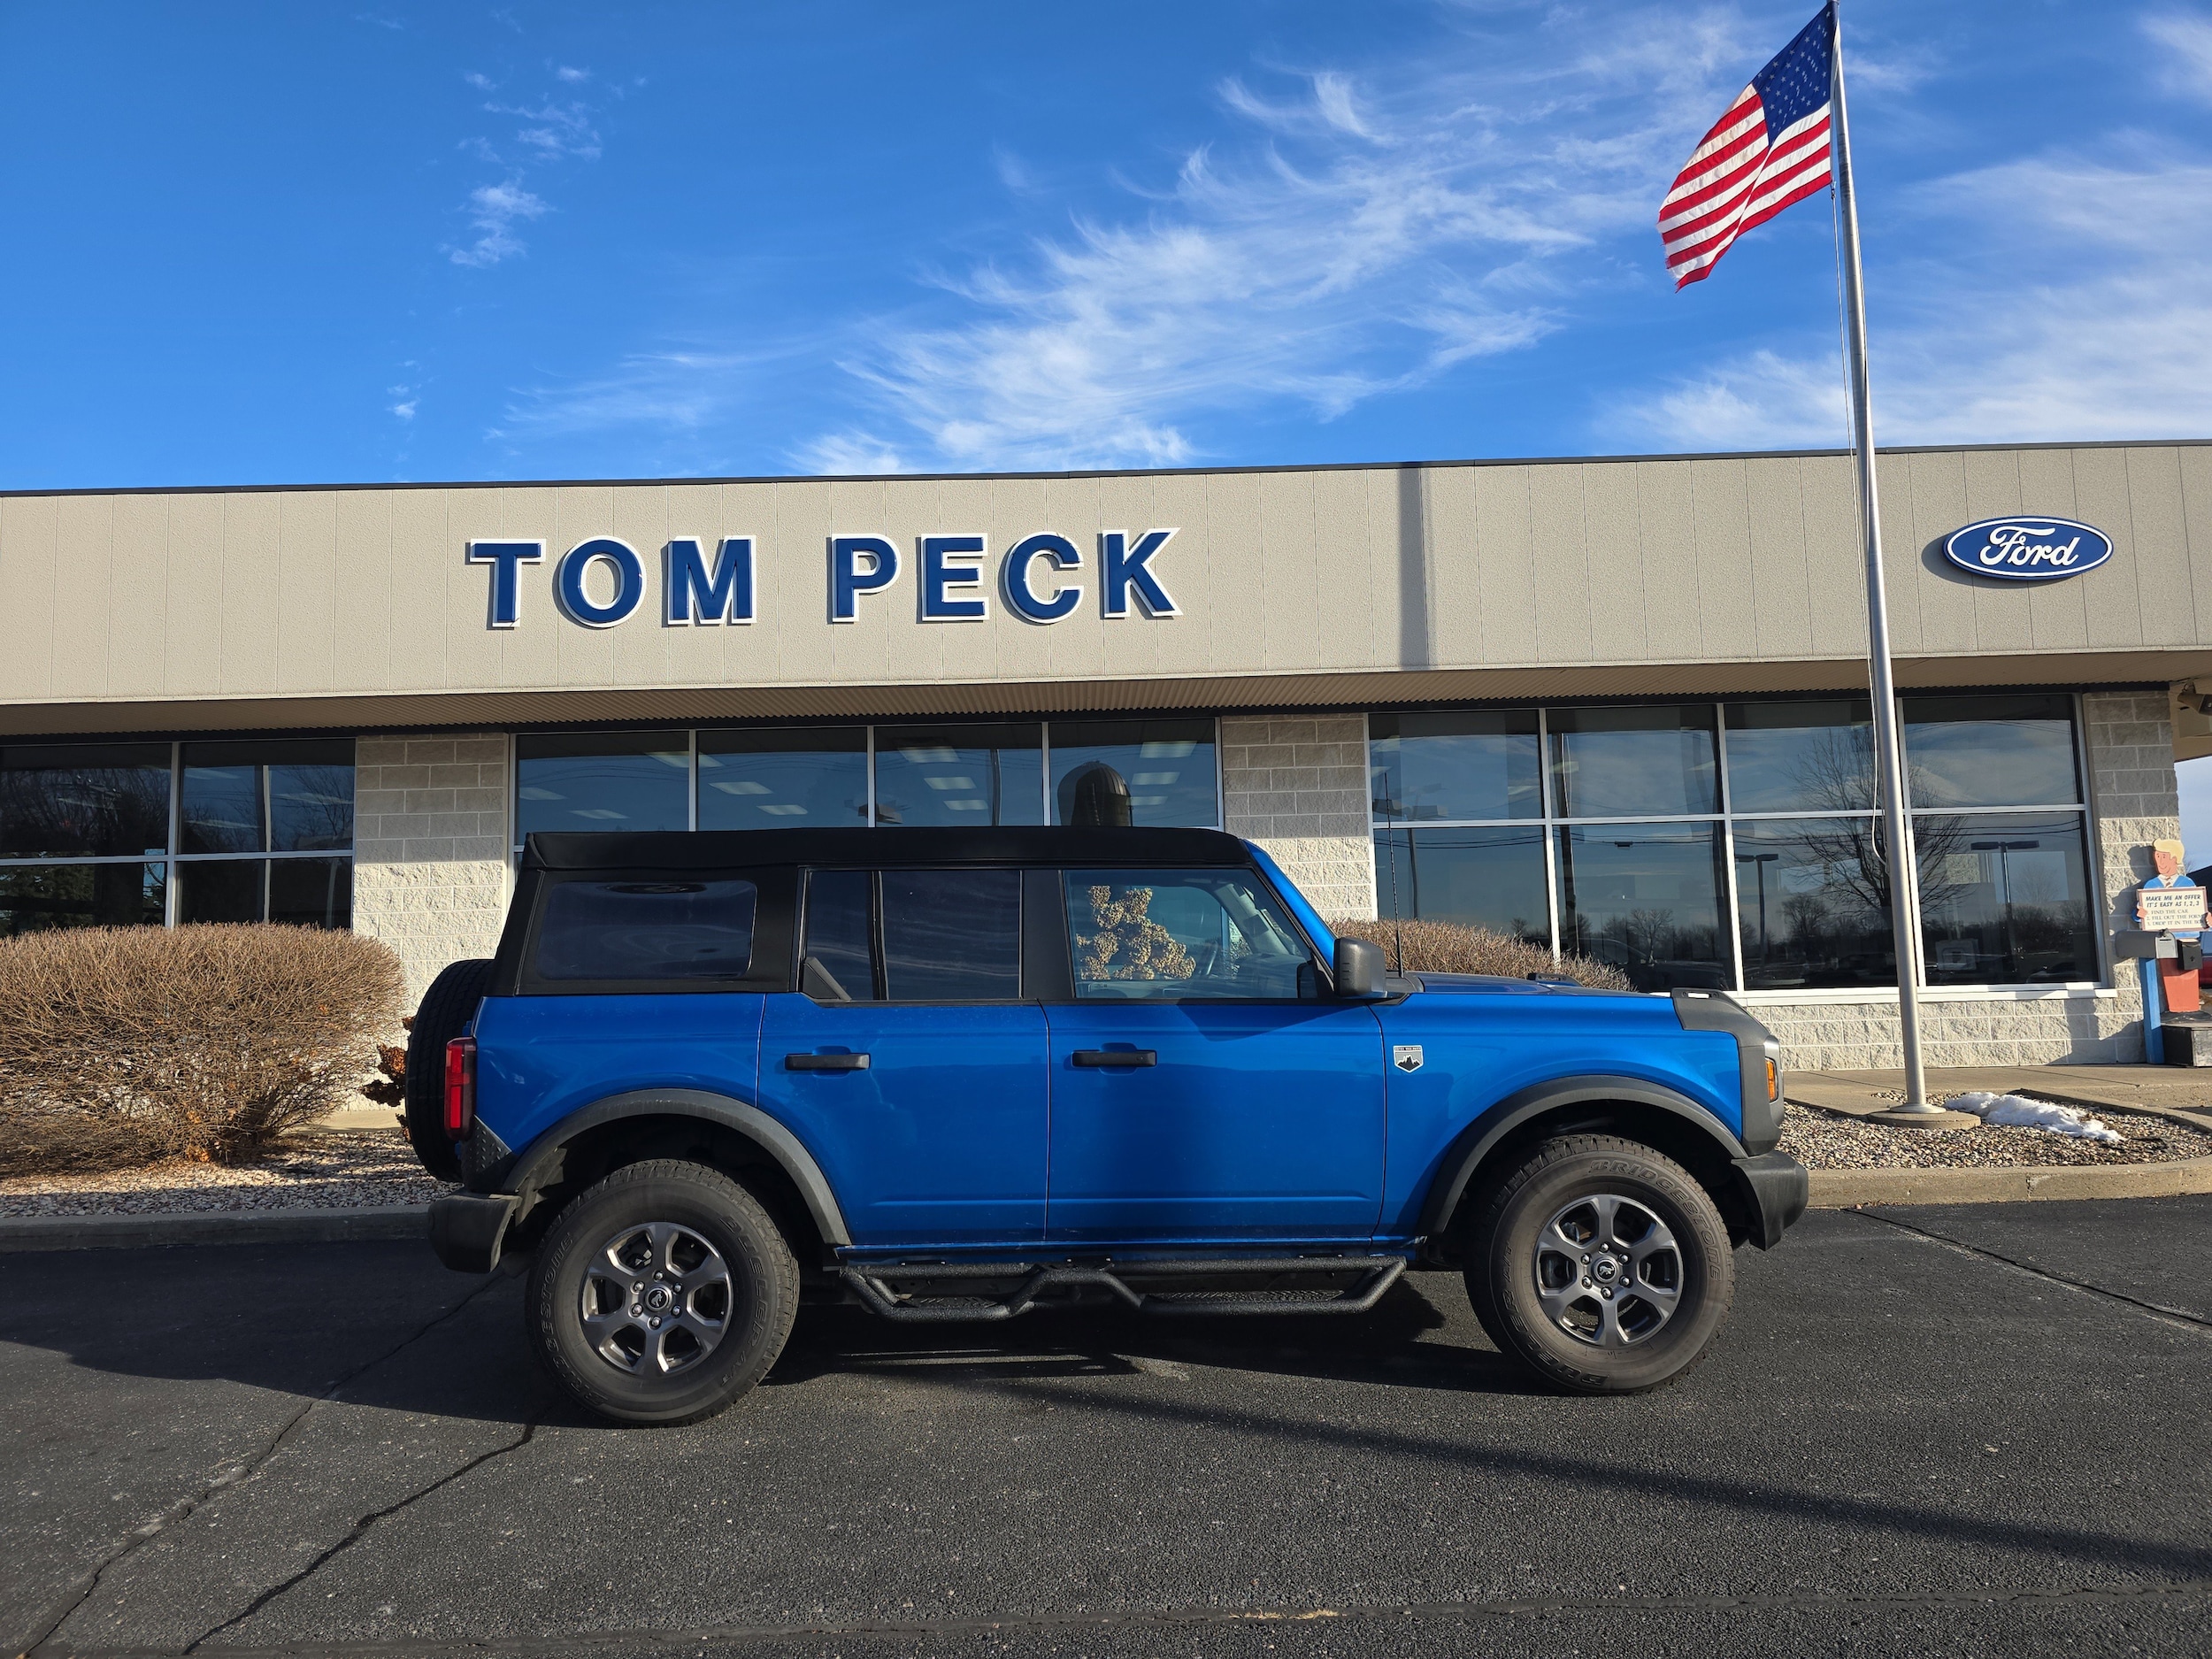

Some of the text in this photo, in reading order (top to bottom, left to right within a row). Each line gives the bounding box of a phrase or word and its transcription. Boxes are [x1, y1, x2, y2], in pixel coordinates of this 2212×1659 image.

[469, 526, 1182, 629] TOM PECK
[1979, 526, 2081, 566] Ford
[1587, 1159, 1723, 1282] BRIDGESTONE
[540, 1232, 609, 1406] BRIDGESTONE
[718, 1214, 769, 1348] DUELER
[1502, 1289, 1610, 1386] DUELER
